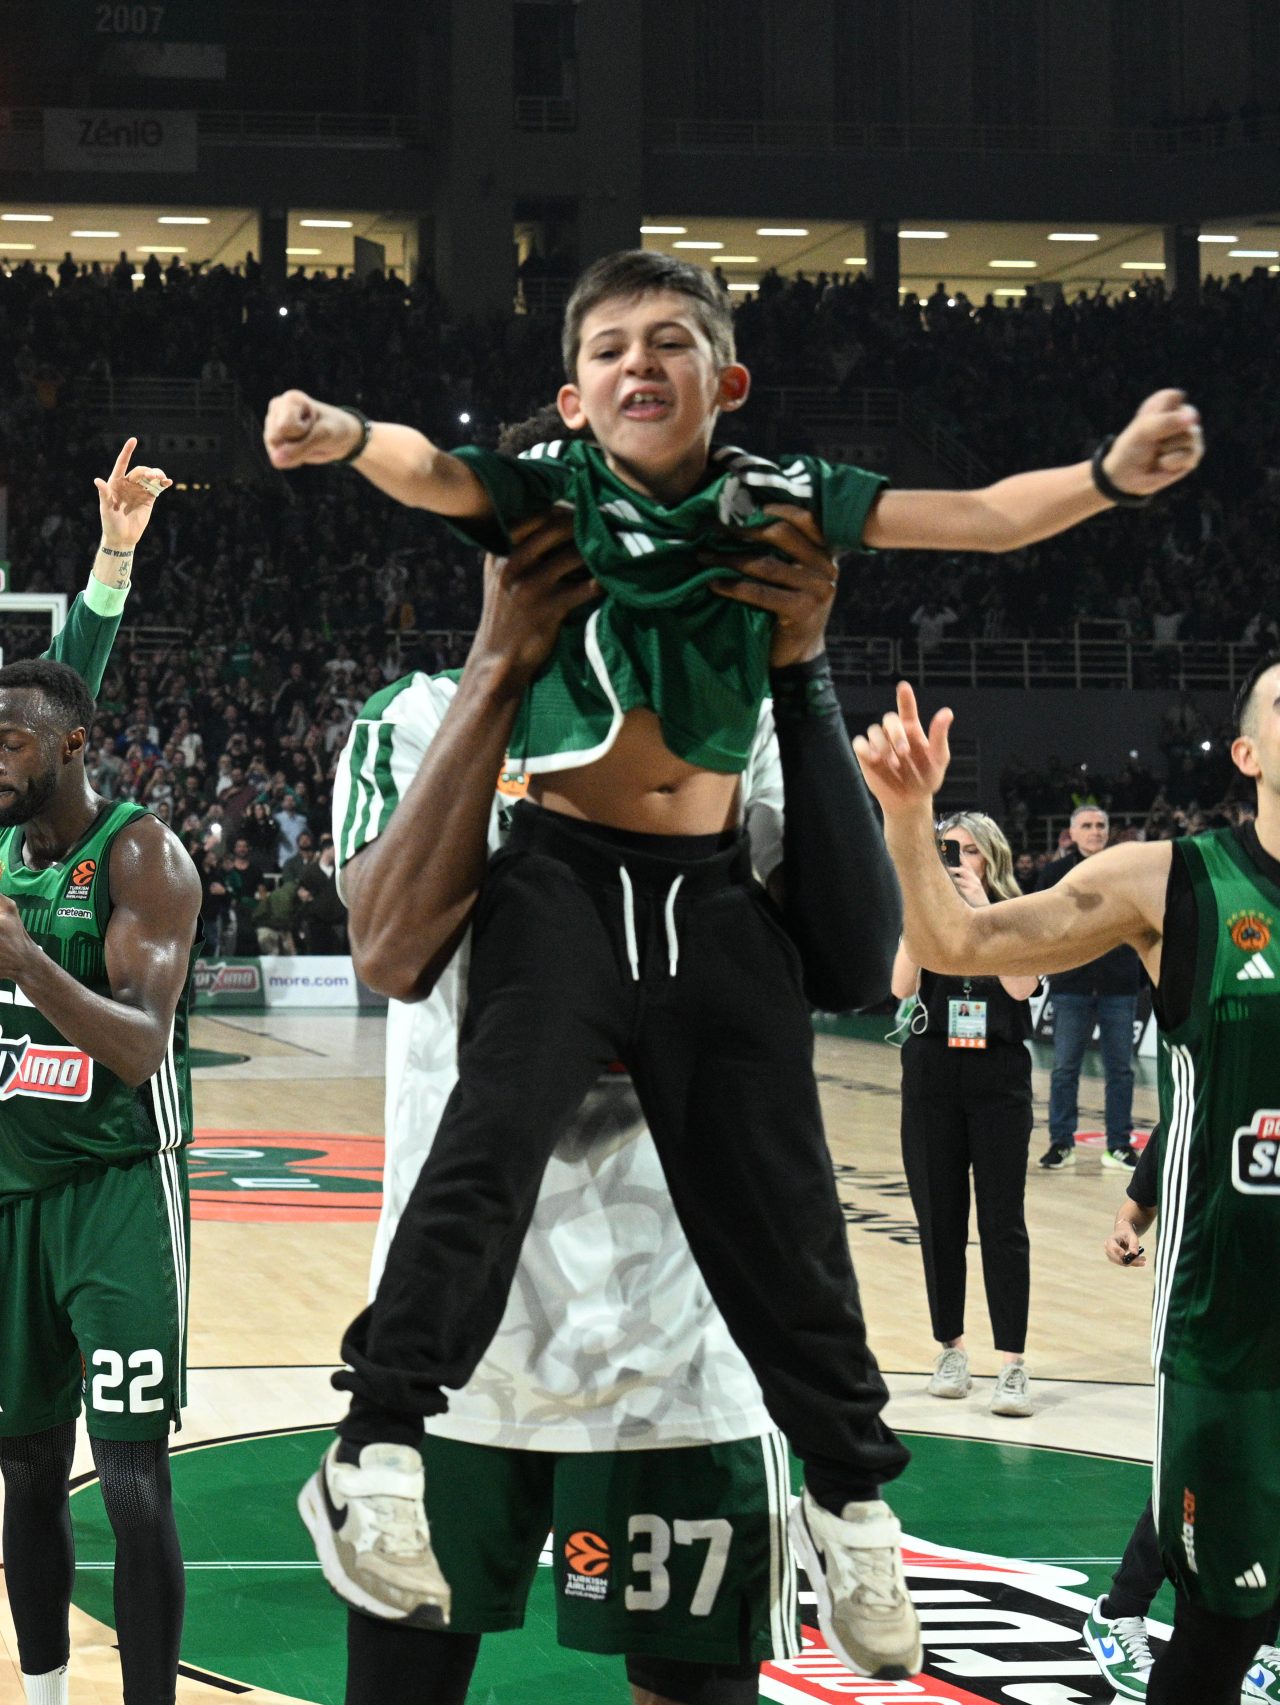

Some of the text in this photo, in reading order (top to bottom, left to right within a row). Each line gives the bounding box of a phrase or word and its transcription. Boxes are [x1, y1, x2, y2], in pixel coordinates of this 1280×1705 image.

[96, 5, 166, 34] 2007
[57, 907, 93, 920] oneteam
[269, 975, 349, 987] more.com
[91, 1348, 165, 1414] 22
[624, 1513, 733, 1616] 37
[567, 1573, 608, 1587] TURKISH
[566, 1581, 607, 1594] AIRLINES
